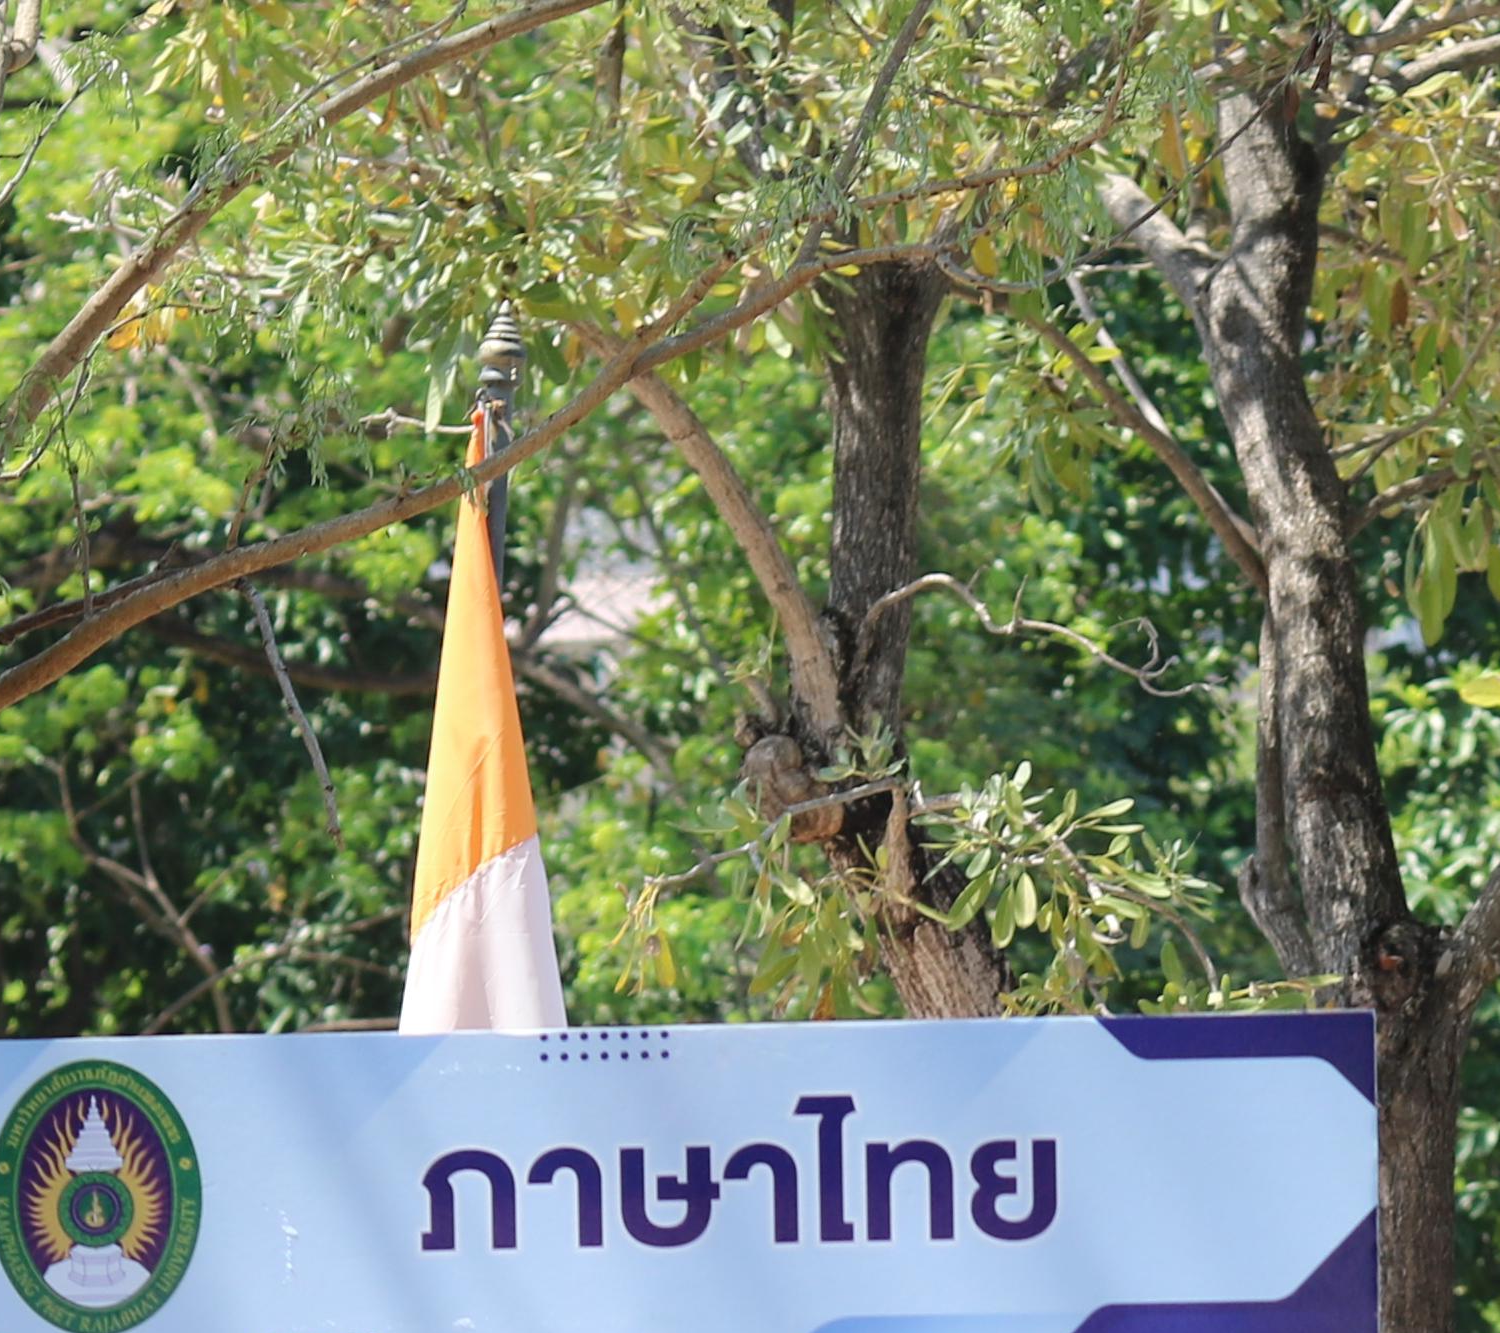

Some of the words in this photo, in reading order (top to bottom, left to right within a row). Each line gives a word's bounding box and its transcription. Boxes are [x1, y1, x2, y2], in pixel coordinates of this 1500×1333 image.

[421, 1094, 1057, 1251] ภาษาไทย
[36, 1296, 75, 1329] PHET
[158, 1197, 197, 1295] UNIVERSITY
